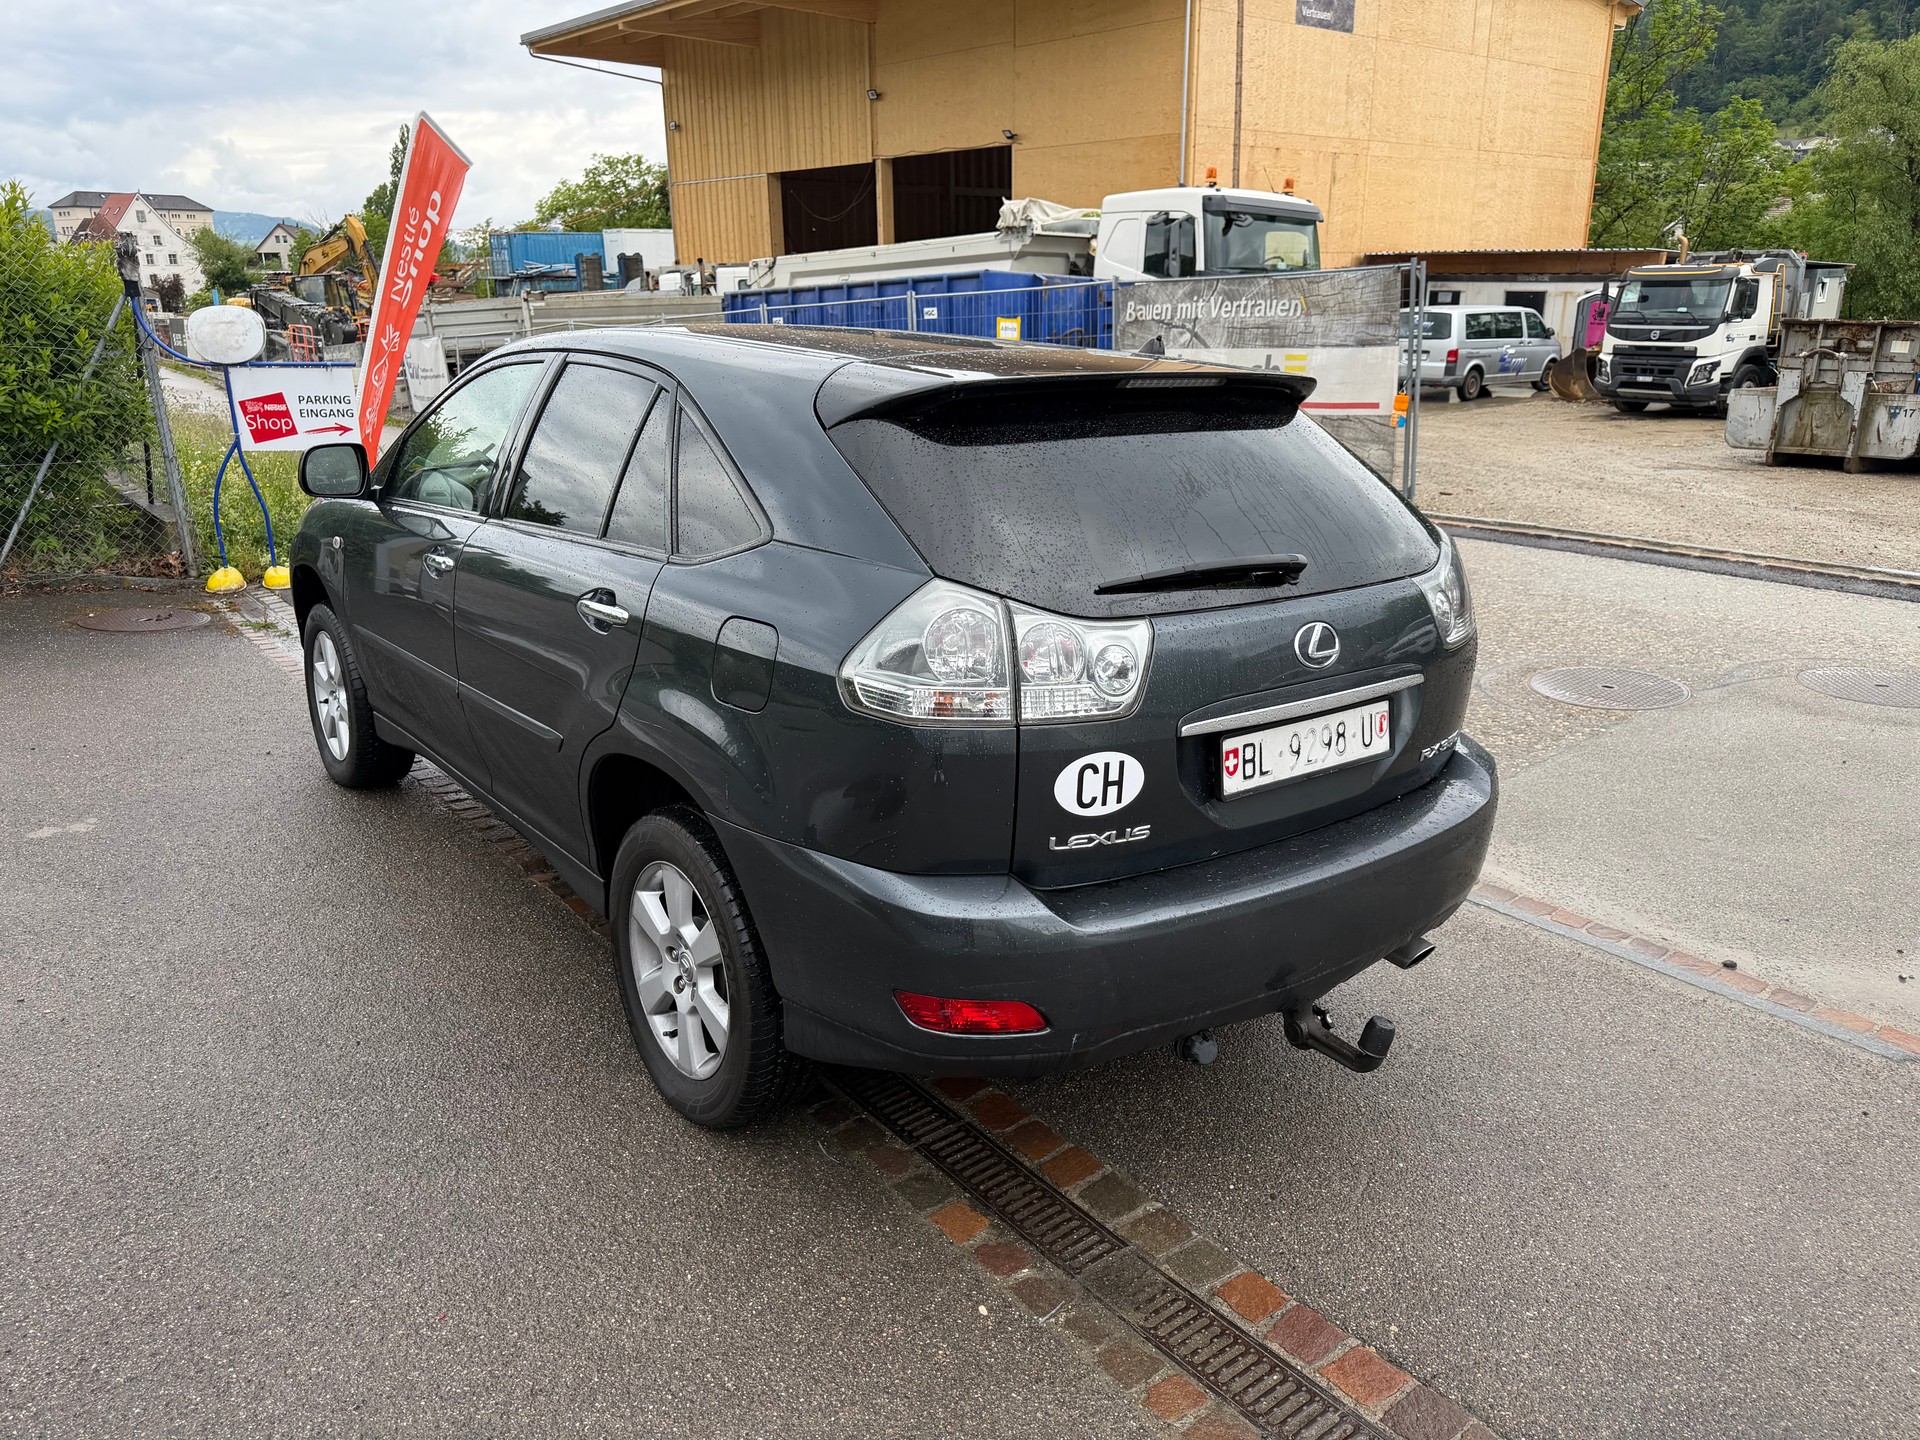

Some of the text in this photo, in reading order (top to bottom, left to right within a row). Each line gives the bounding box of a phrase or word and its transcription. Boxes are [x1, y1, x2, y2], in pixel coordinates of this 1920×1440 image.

[390, 206, 420, 303] Nestlé
[1125, 295, 1311, 322] Bauen mit Vertrauen!
[298, 395, 352, 405] PARKING
[300, 409, 354, 418] EINGANG
[1903, 408, 1916, 418] 17
[245, 414, 293, 434] Shop
[1242, 712, 1373, 781] BL 9298 U
[1076, 760, 1125, 809] CH
[1048, 824, 1151, 851] LEXUS
